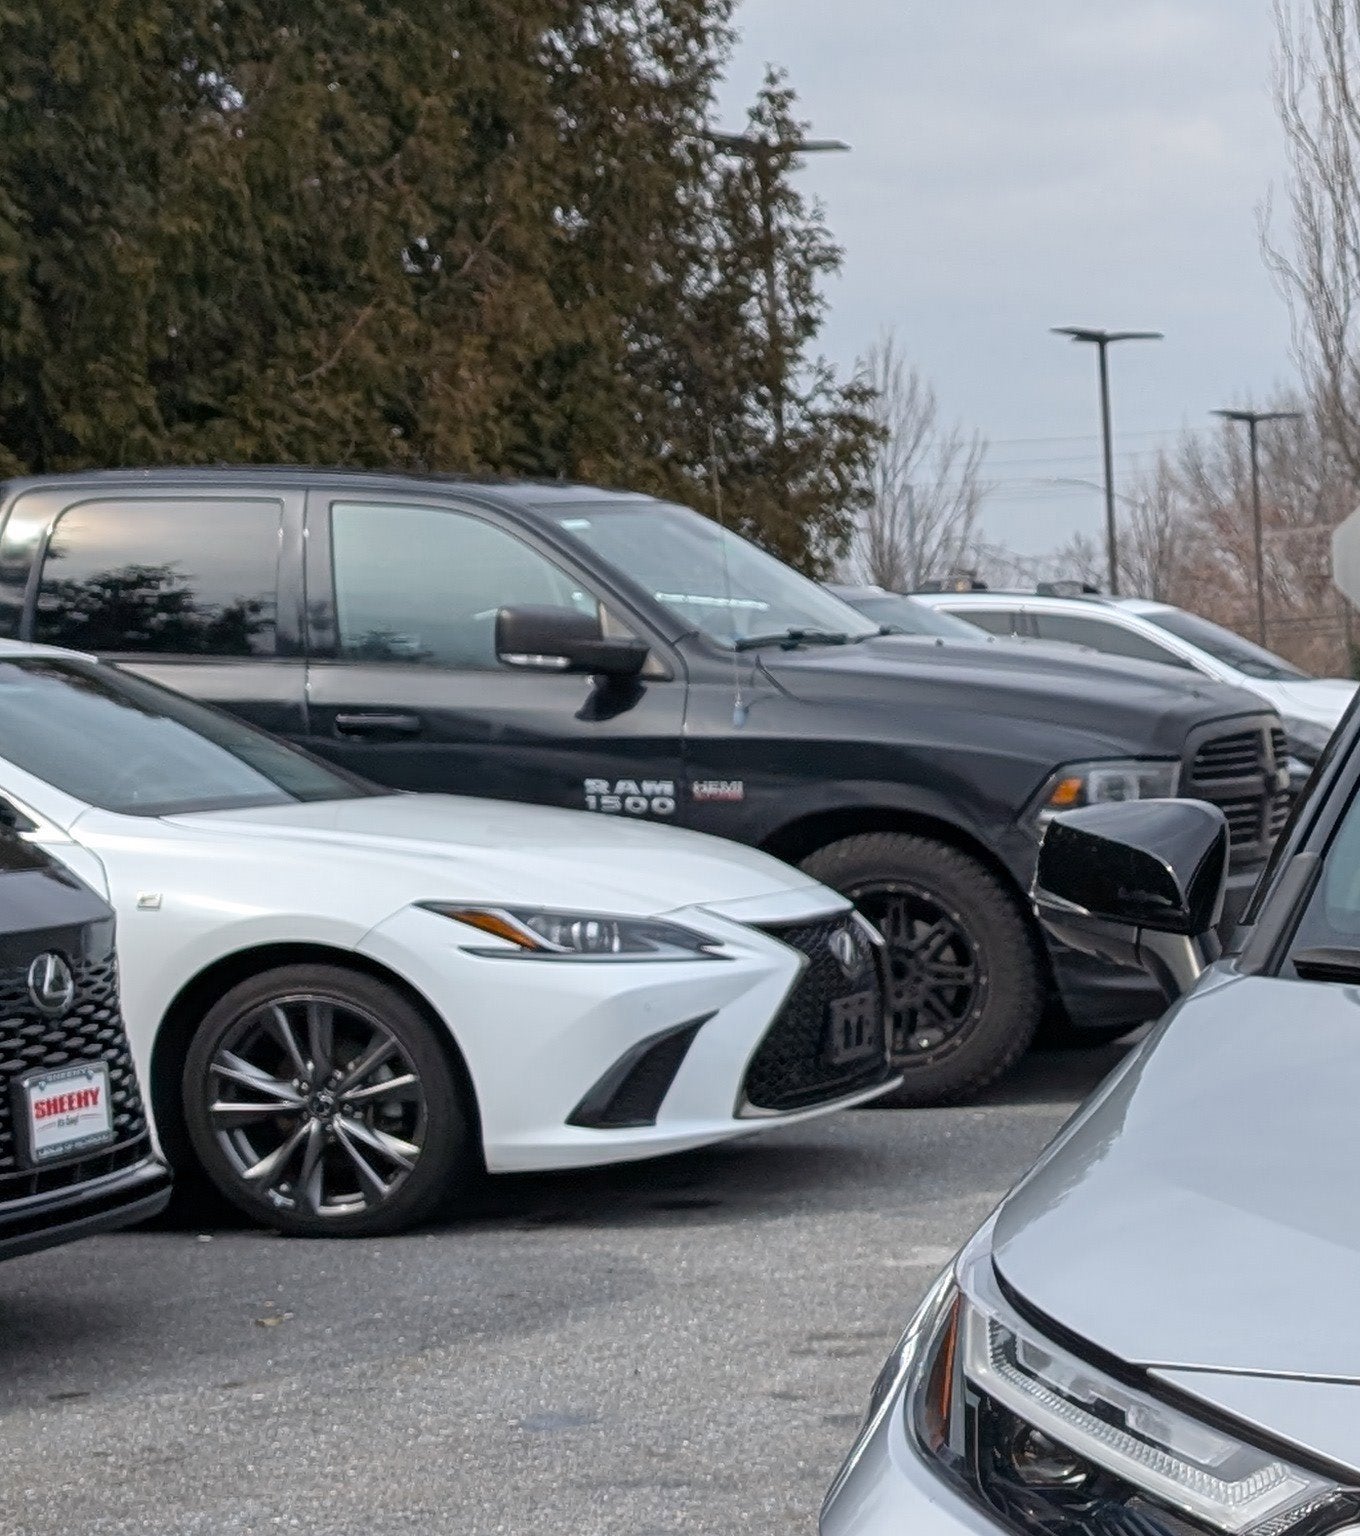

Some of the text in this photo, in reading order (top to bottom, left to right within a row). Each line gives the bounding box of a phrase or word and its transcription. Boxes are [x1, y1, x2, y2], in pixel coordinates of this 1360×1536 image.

[584, 778, 675, 796] RAM
[584, 796, 676, 814] 1500
[34, 1087, 99, 1118] SHEEHY
